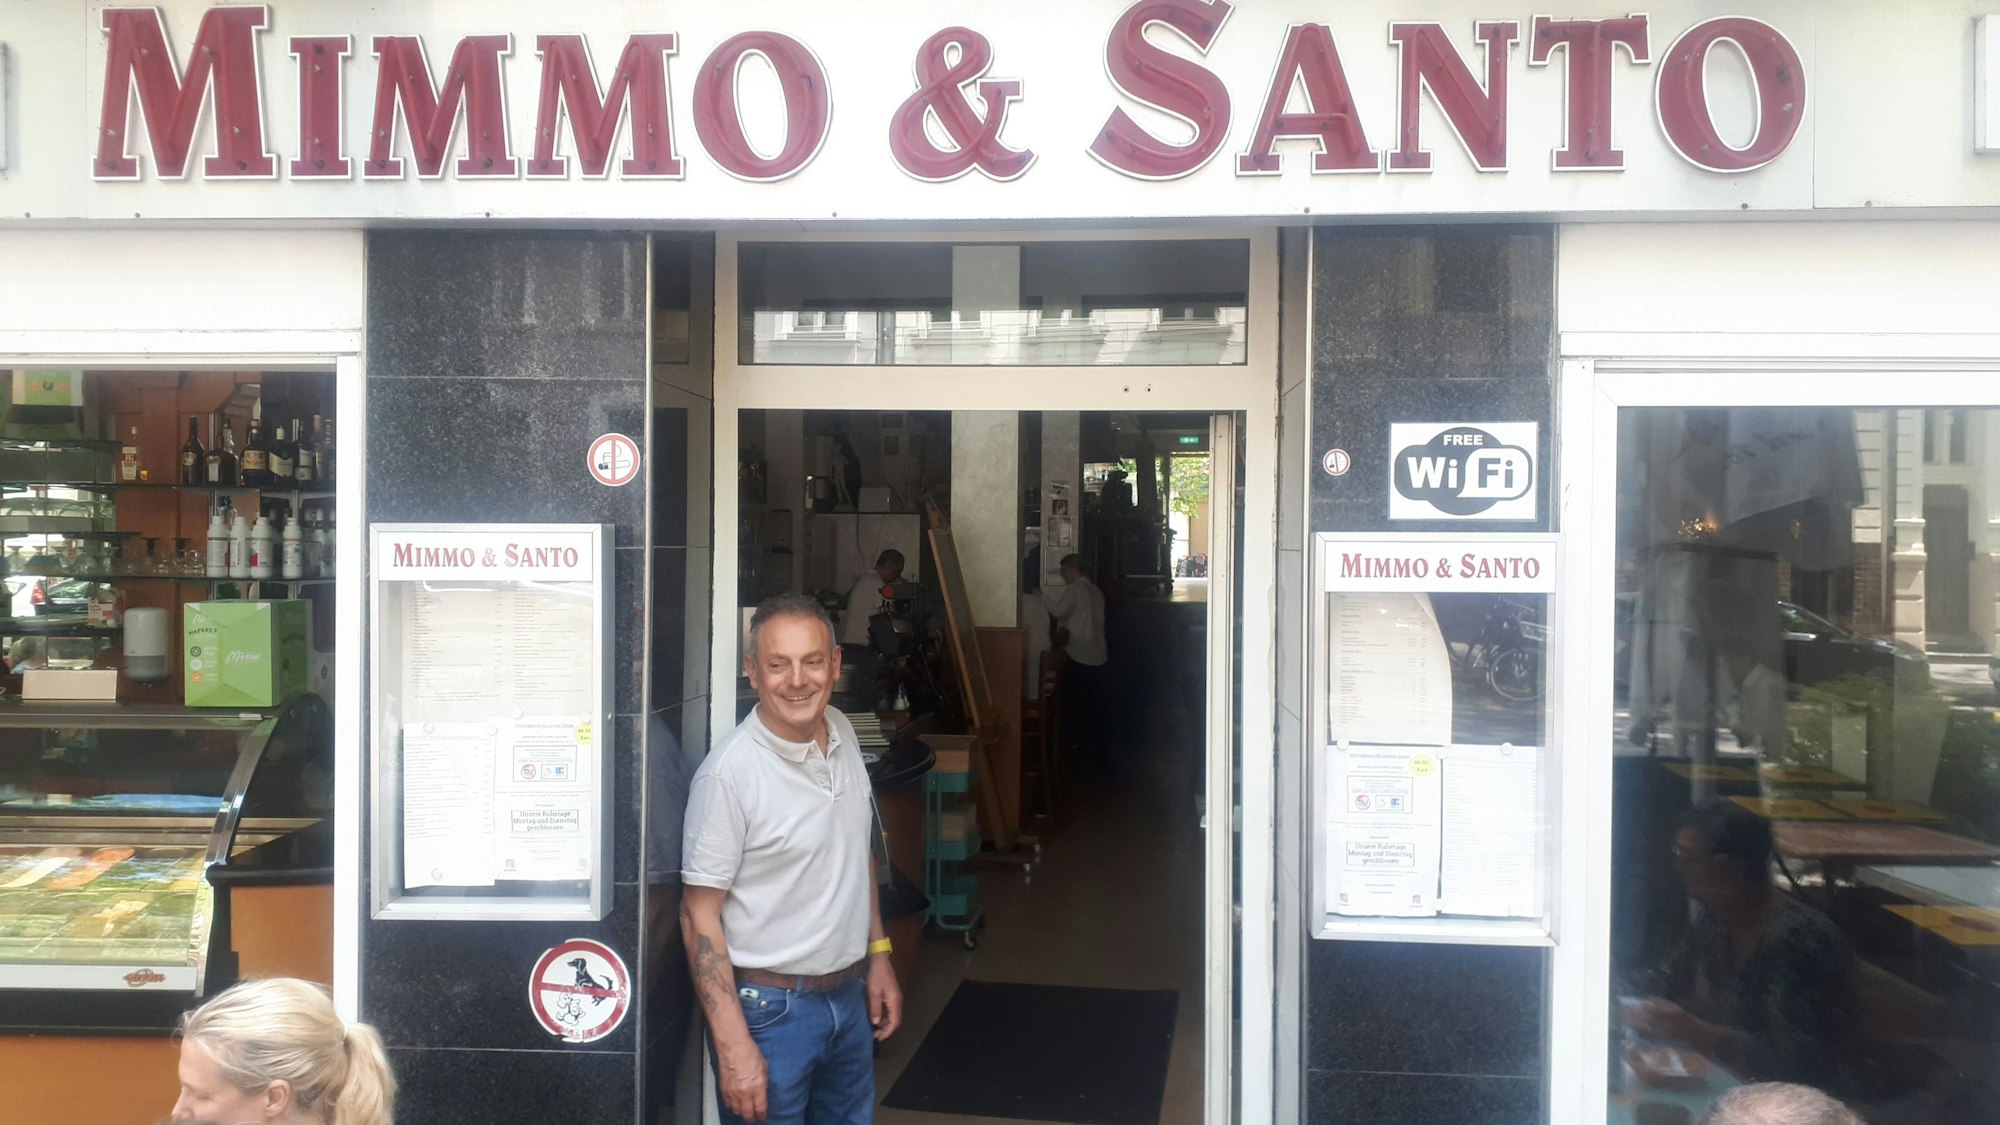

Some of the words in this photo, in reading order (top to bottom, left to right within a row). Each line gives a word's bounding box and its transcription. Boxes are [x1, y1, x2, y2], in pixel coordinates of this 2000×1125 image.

[92, 5, 833, 183] MIMMO
[891, 27, 1038, 182] &
[1086, 0, 1808, 180] SANTO
[1443, 434, 1483, 446] FREE
[393, 543, 476, 567] MIMMO
[481, 547, 498, 567] &
[504, 543, 579, 568] SANTO
[1340, 553, 1429, 578] MIMMO
[1436, 557, 1453, 578] &
[1459, 552, 1540, 578] SANTO
[542, 809, 571, 818] Ruhetage
[513, 817, 536, 825] Montag
[549, 817, 577, 825] Dienstag
[526, 824, 564, 832] geschlossen
[1348, 849, 1371, 858] Montag
